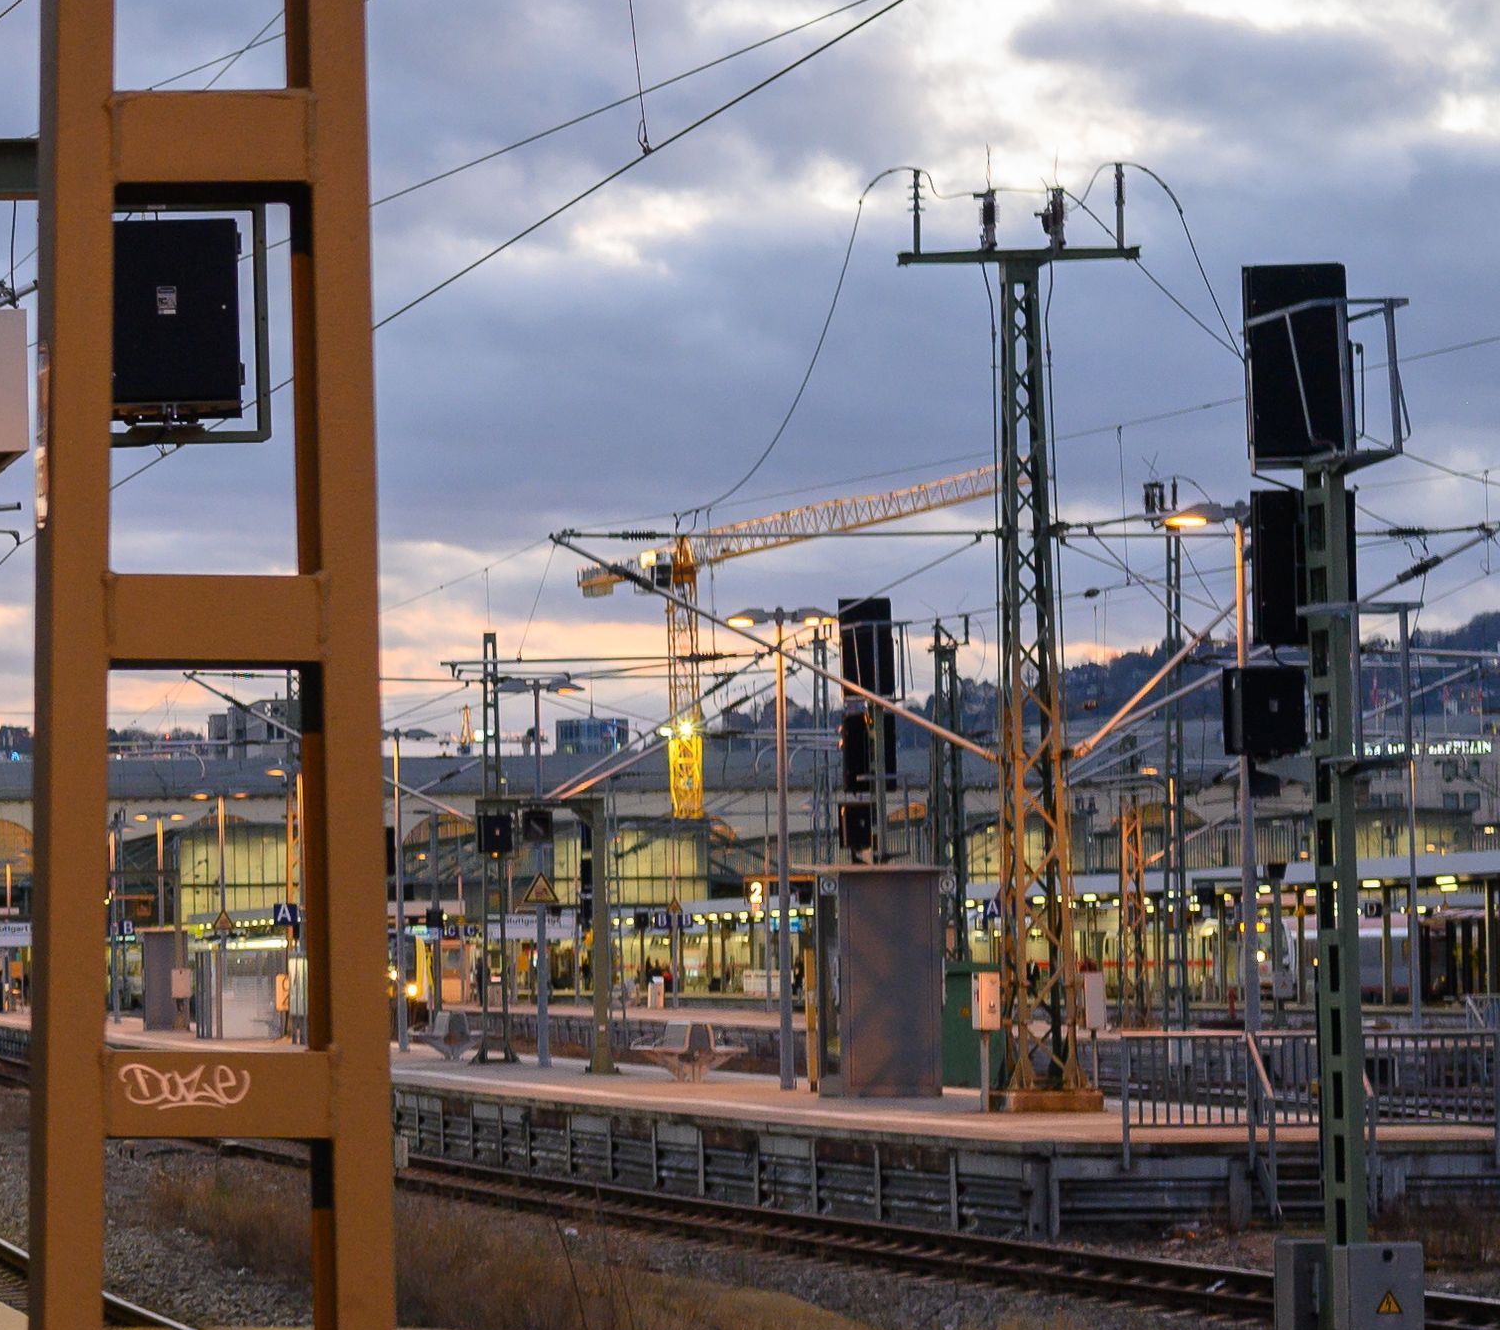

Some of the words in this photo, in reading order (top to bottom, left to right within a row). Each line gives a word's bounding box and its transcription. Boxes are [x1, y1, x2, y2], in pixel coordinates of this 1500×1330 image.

[750, 881, 763, 904] 2
[277, 903, 292, 922] A
[986, 899, 999, 917] A
[123, 920, 134, 935] B
